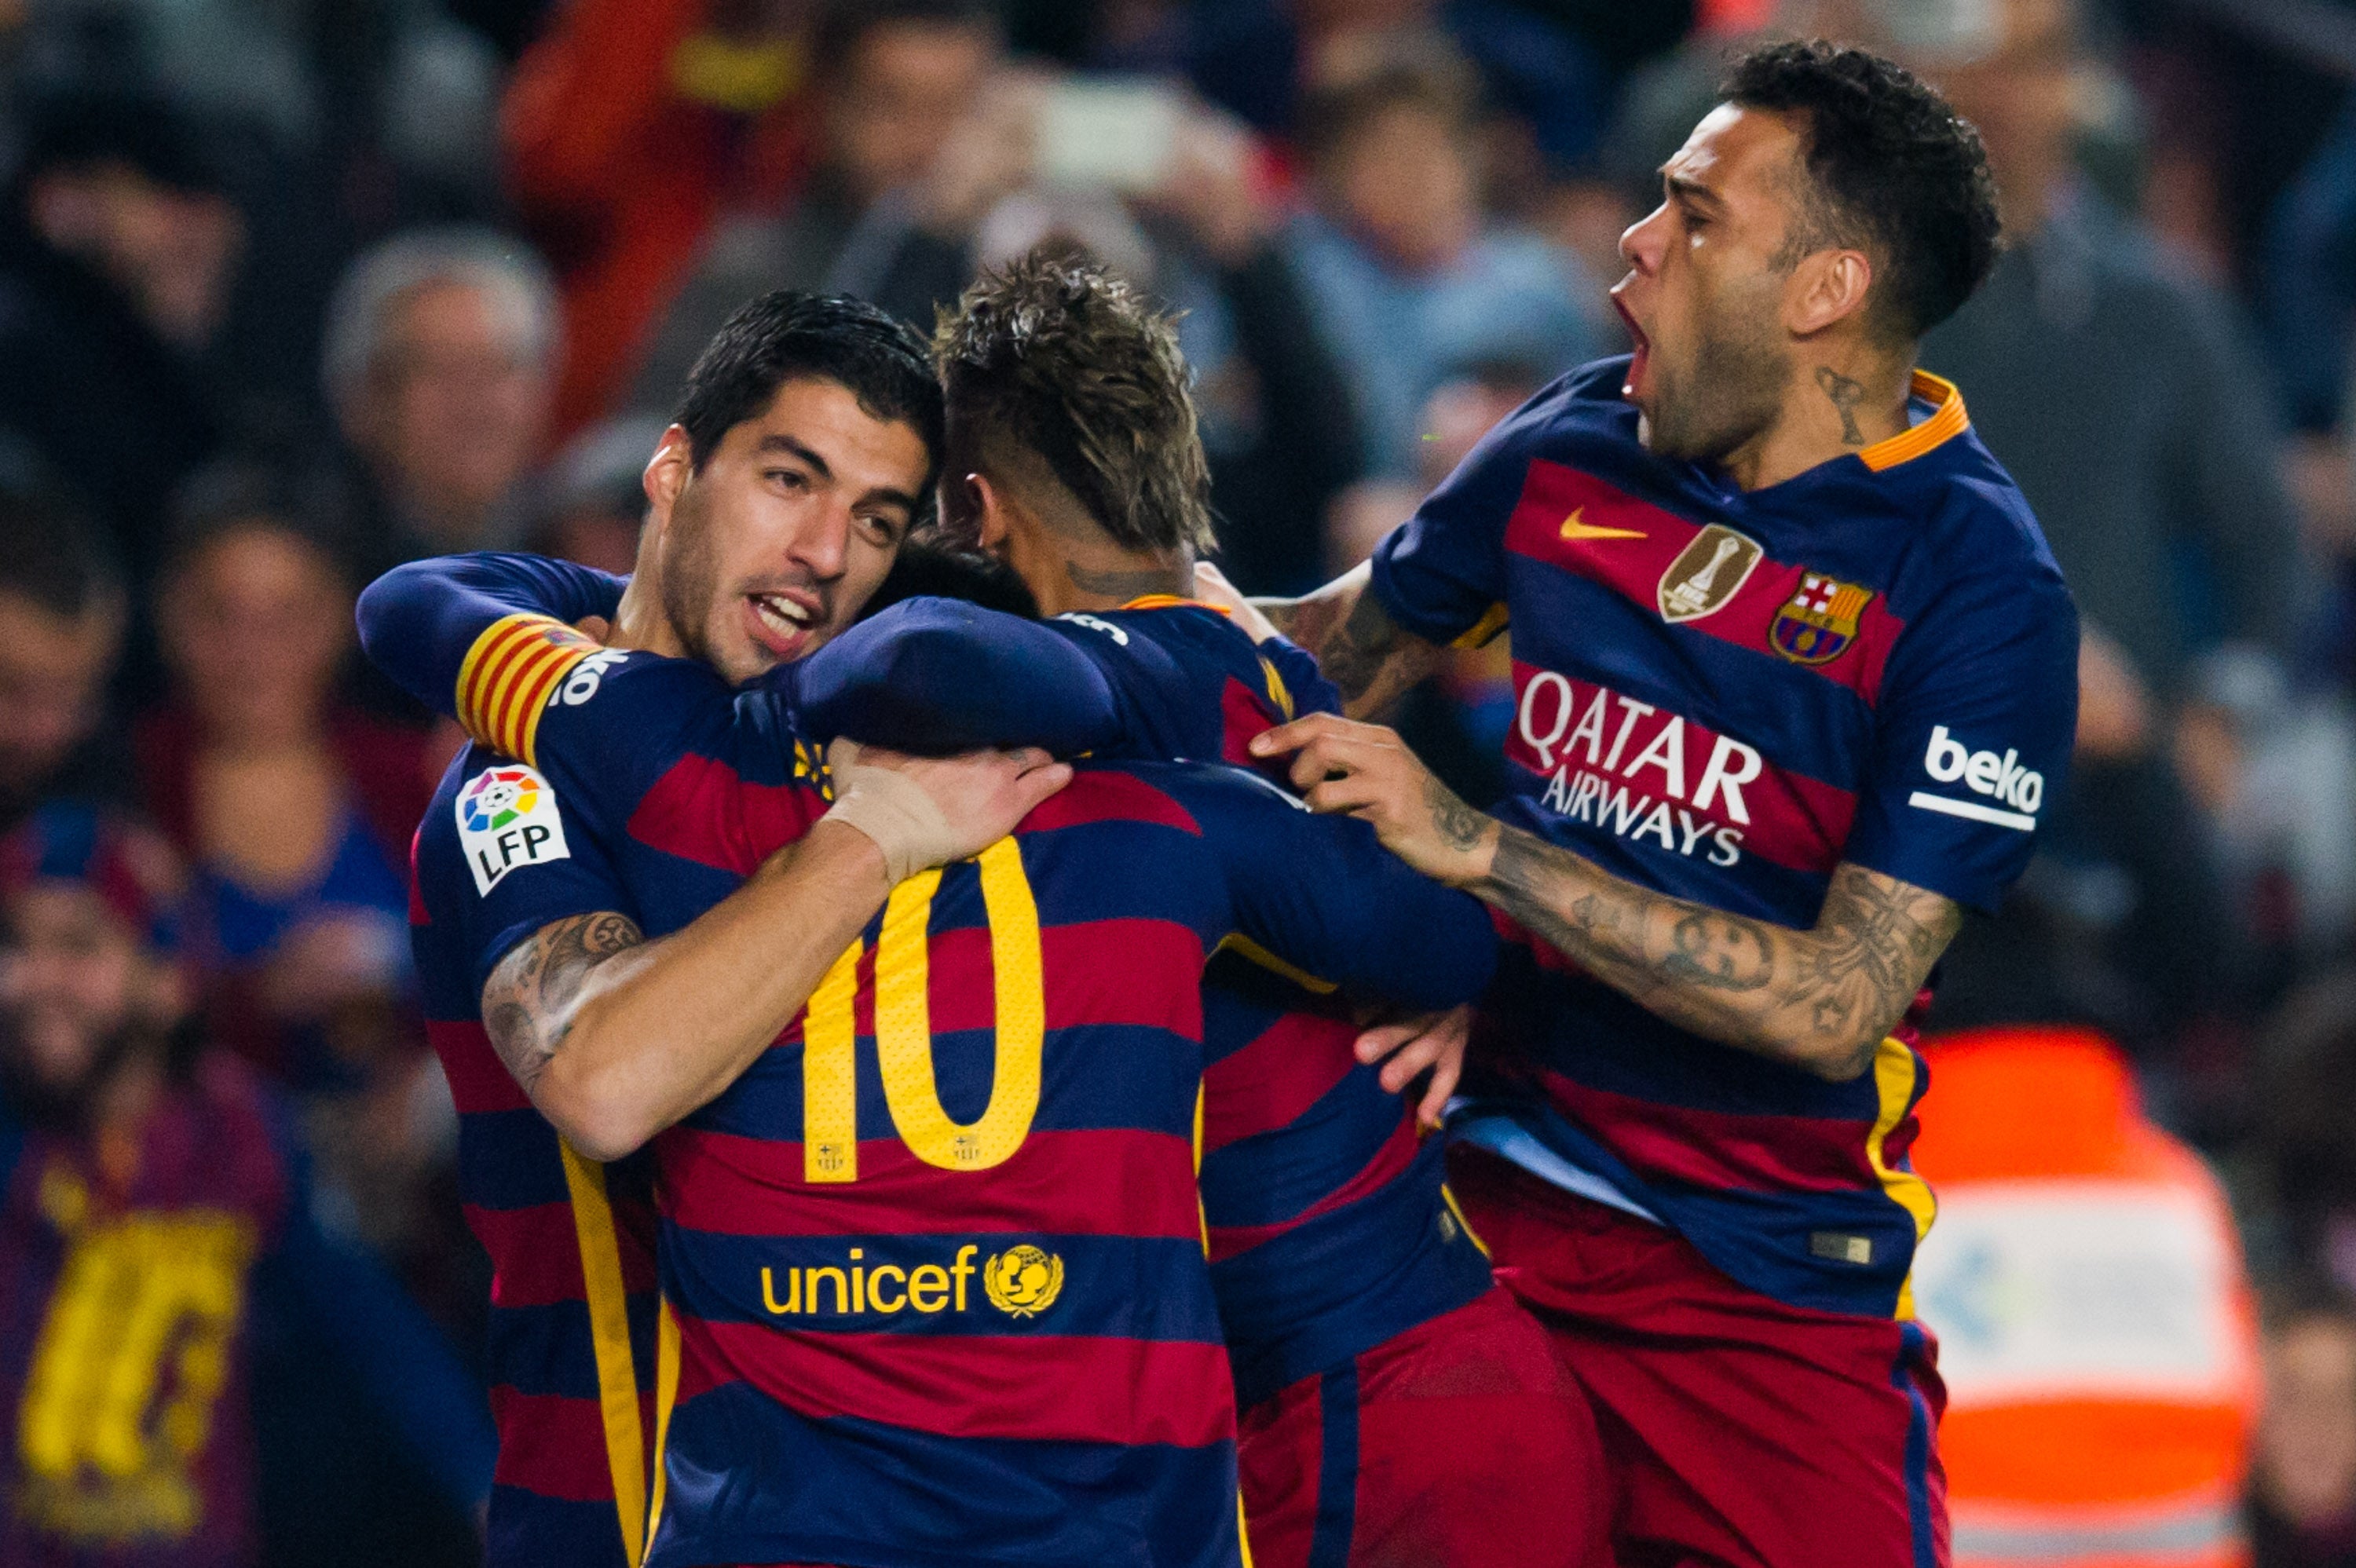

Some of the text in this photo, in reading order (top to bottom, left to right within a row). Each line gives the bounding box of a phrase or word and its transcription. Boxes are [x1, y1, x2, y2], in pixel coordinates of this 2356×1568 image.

[1519, 671, 1763, 825] QATAR
[1925, 725, 2044, 813] beko
[477, 824, 551, 884] LFP
[1541, 763, 1744, 867] AIRWAYS
[803, 834, 1045, 1183] 10
[761, 1244, 979, 1314] unicef
